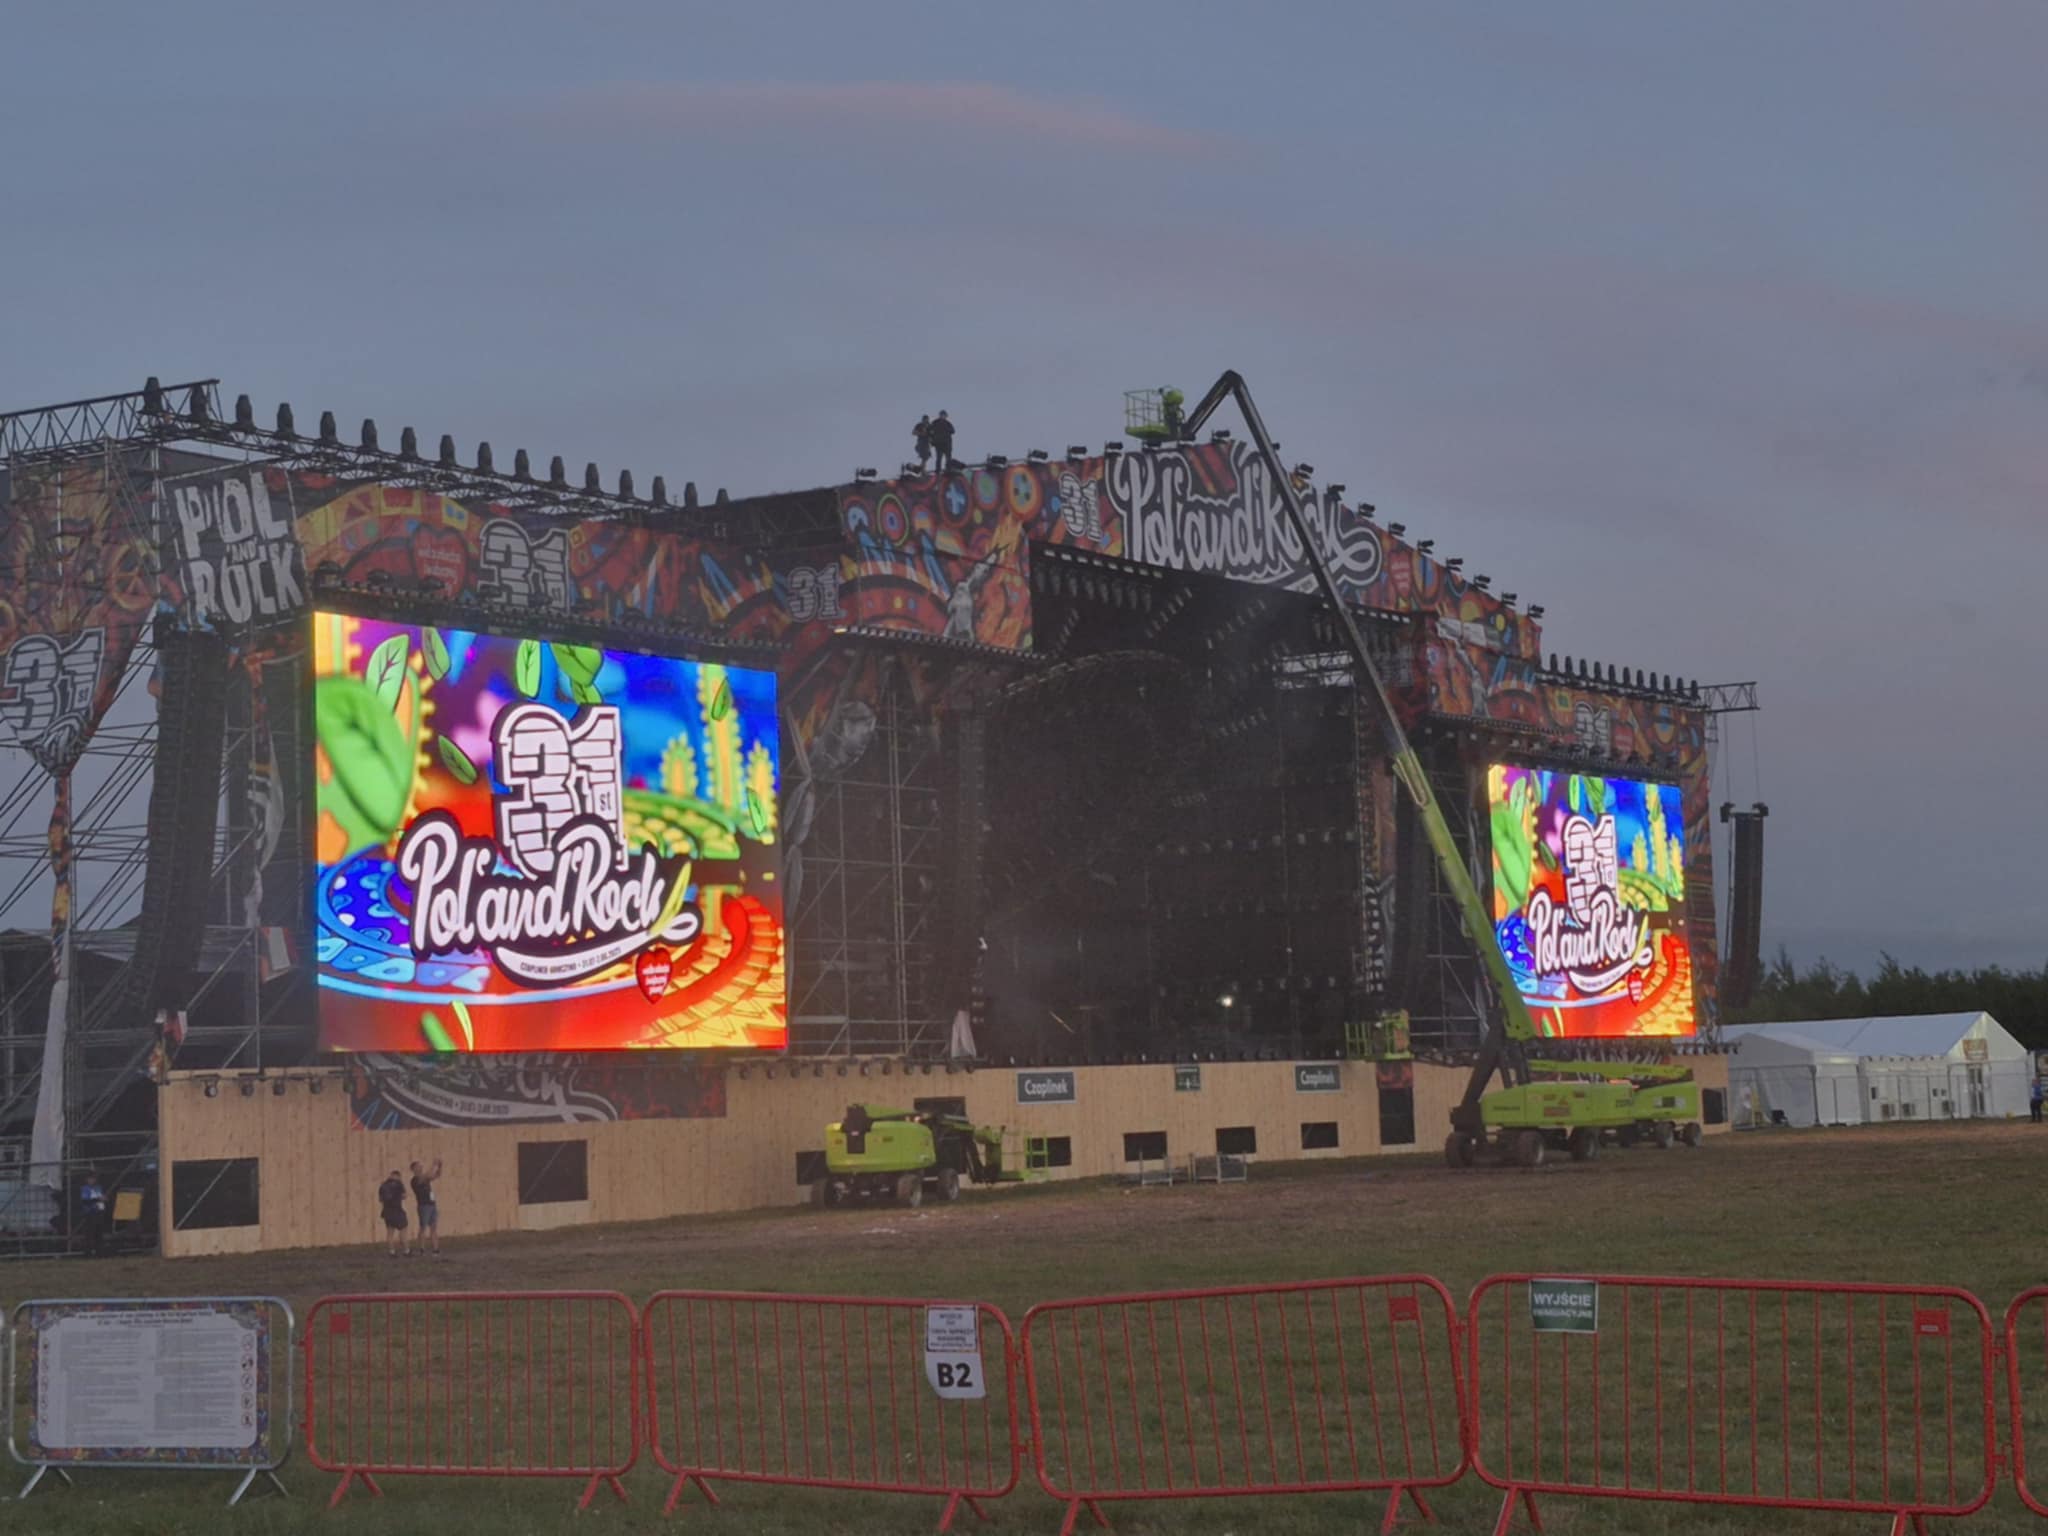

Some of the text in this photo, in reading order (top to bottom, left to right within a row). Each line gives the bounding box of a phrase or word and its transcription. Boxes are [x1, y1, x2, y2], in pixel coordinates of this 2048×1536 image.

[174, 472, 288, 559] POL
[1060, 473, 1102, 543] 31
[193, 542, 302, 623] ROCK
[1024, 1078, 1068, 1098] Czaplinek
[1533, 1290, 1592, 1306] WYJŚCIE
[937, 1362, 973, 1388] B2
